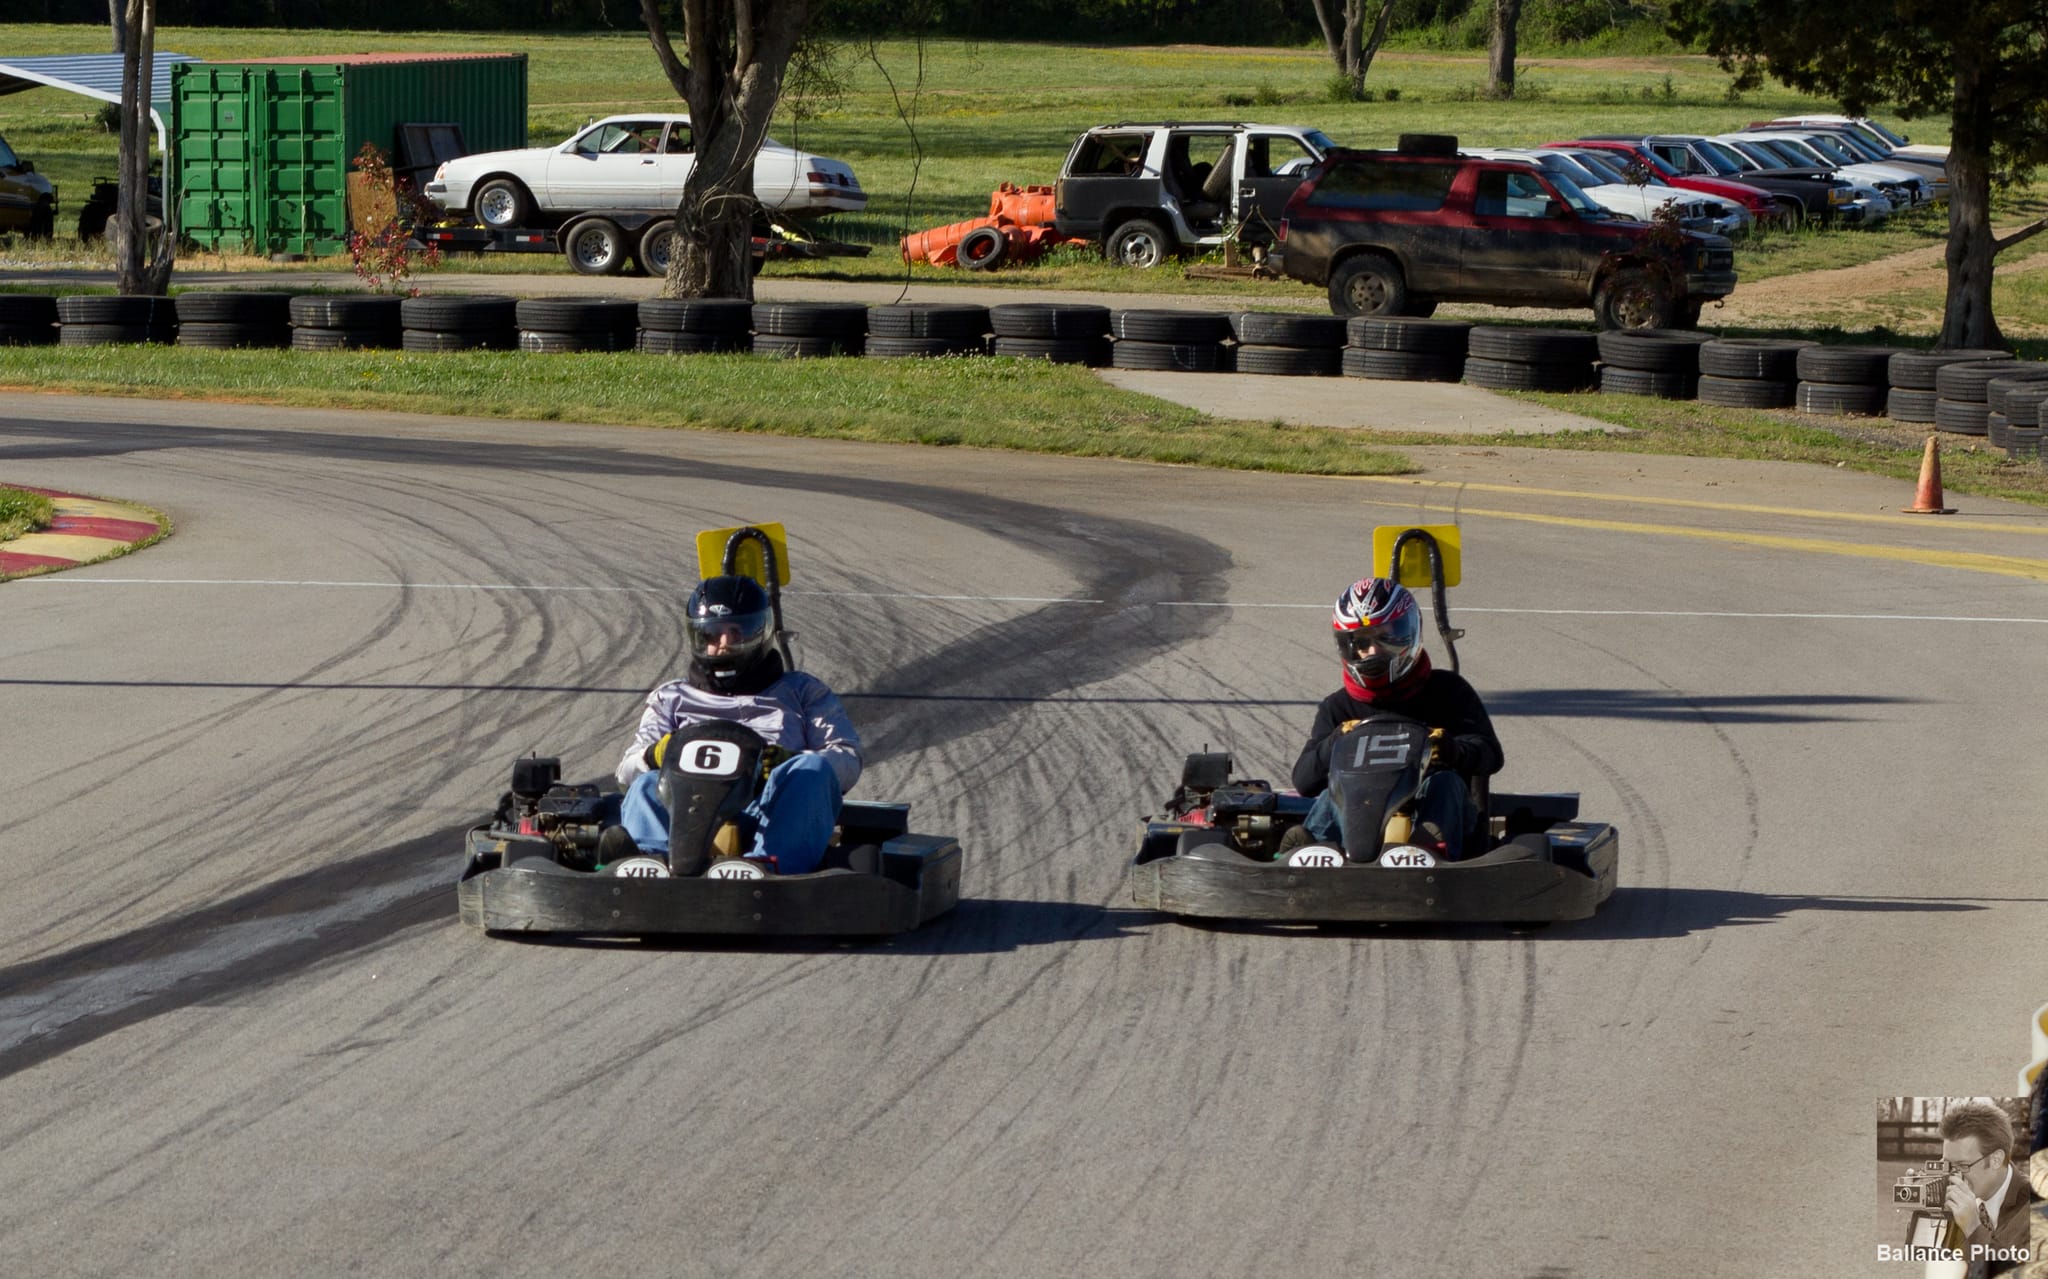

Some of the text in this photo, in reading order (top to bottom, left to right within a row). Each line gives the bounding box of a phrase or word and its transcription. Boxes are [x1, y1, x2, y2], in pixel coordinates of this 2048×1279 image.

[1353, 732, 1411, 768] 15
[694, 744, 722, 770] 6
[1298, 855, 1334, 867] VIR
[1390, 853, 1427, 867] VIR
[624, 867, 659, 878] VIR
[717, 868, 753, 880] VIR
